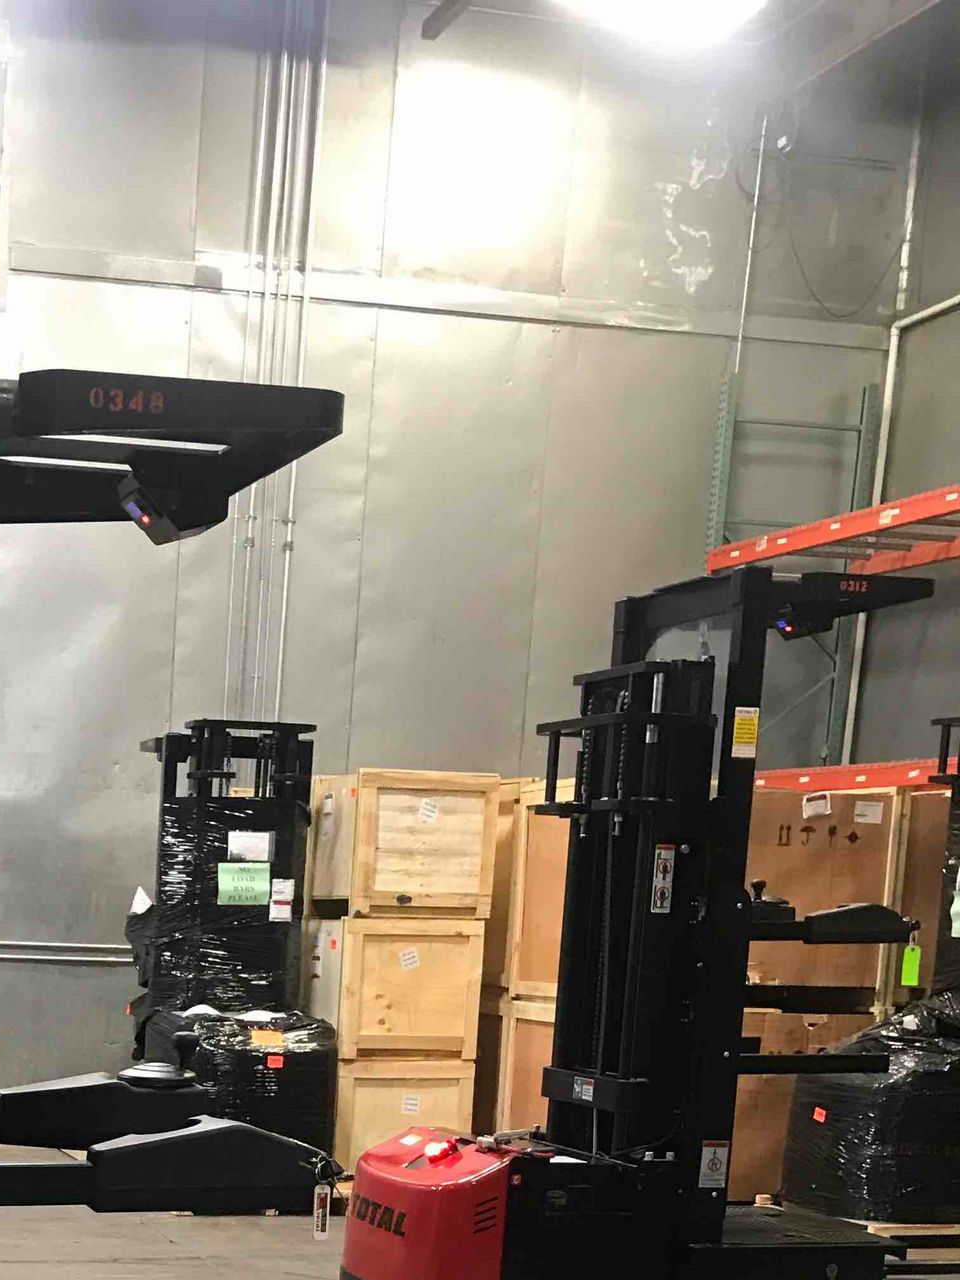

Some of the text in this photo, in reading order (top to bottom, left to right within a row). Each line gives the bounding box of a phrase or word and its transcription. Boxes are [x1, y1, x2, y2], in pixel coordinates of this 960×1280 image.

[89, 386, 165, 414] 0348
[839, 580, 868, 592] 0312
[351, 1193, 407, 1238] TOTAL
